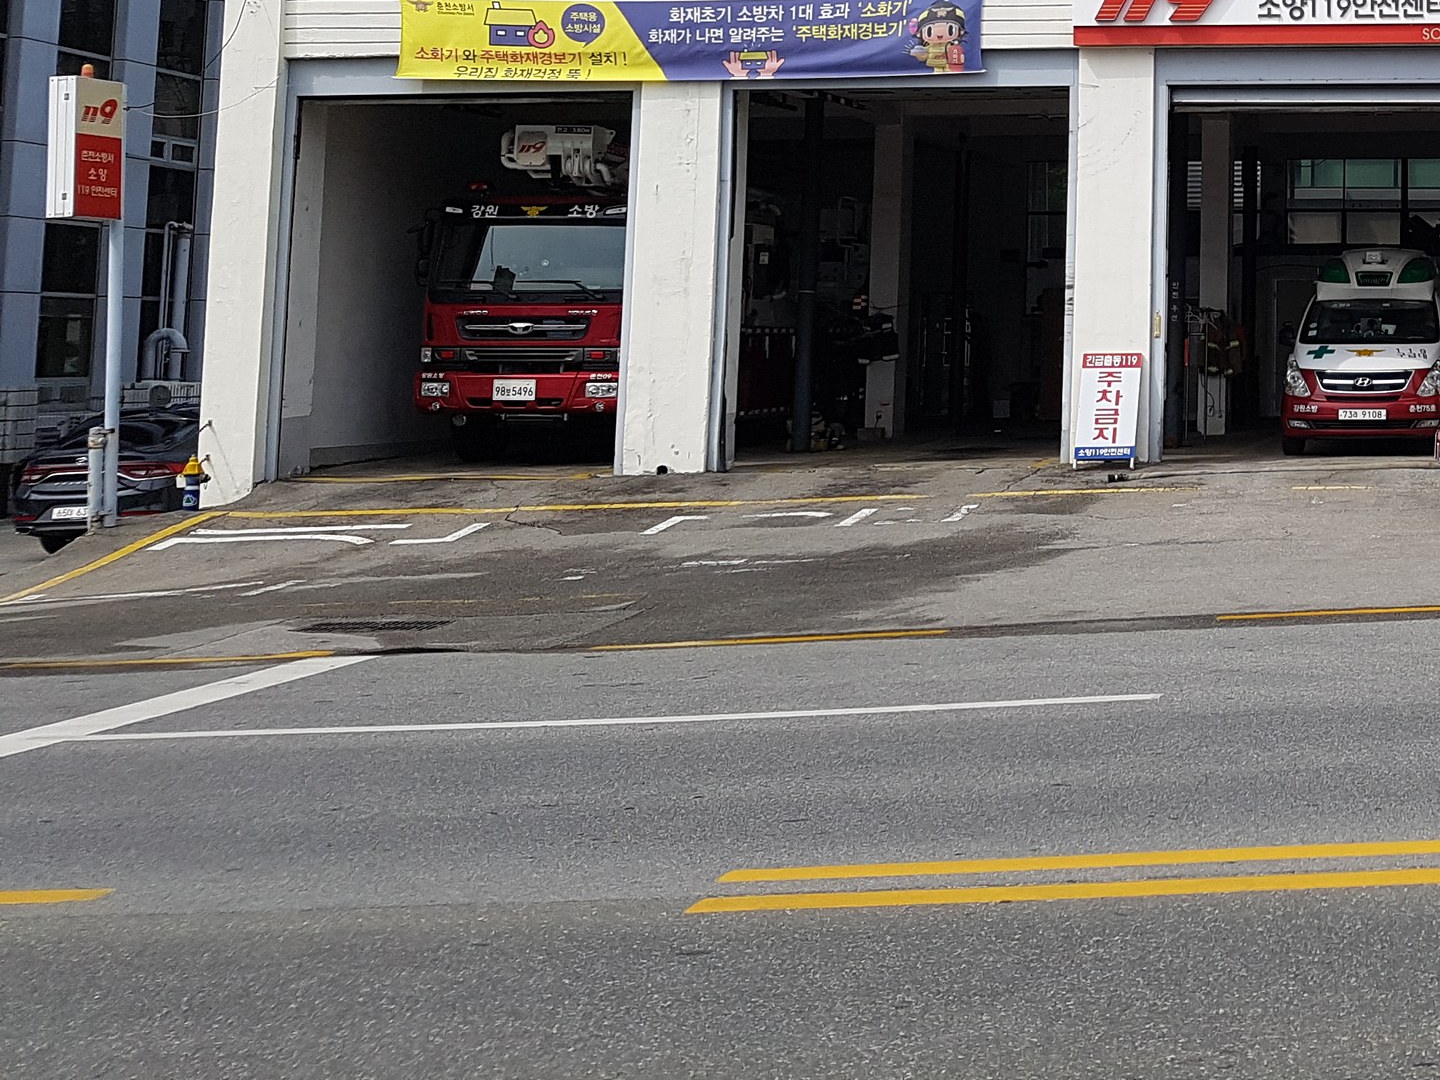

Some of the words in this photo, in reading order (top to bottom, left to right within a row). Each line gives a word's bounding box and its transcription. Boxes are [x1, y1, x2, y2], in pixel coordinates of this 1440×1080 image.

[569, 11, 598, 22] 주택용
[669, 5, 732, 24] 화재초기
[736, 4, 784, 23] 소방차
[790, 2, 813, 20] 1대
[818, 1, 850, 19] 효과
[564, 22, 601, 34] 소방시설
[648, 27, 692, 44] 화재가
[696, 27, 724, 43] 나면
[728, 25, 784, 43] 알려주는
[415, 46, 459, 63] 소화기
[480, 50, 582, 66] 주택화재경보기
[453, 65, 498, 79] 우리집
[501, 67, 562, 80] 화재걱정
[81, 98, 118, 125] 119
[518, 141, 546, 153] 119
[77, 184, 90, 195] 119
[470, 205, 499, 218] 강원
[567, 204, 599, 218] 소방
[1086, 355, 1138, 367] 긴급출동119
[1092, 371, 1123, 444] 주차금지
[1361, 410, 1382, 419] 9108
